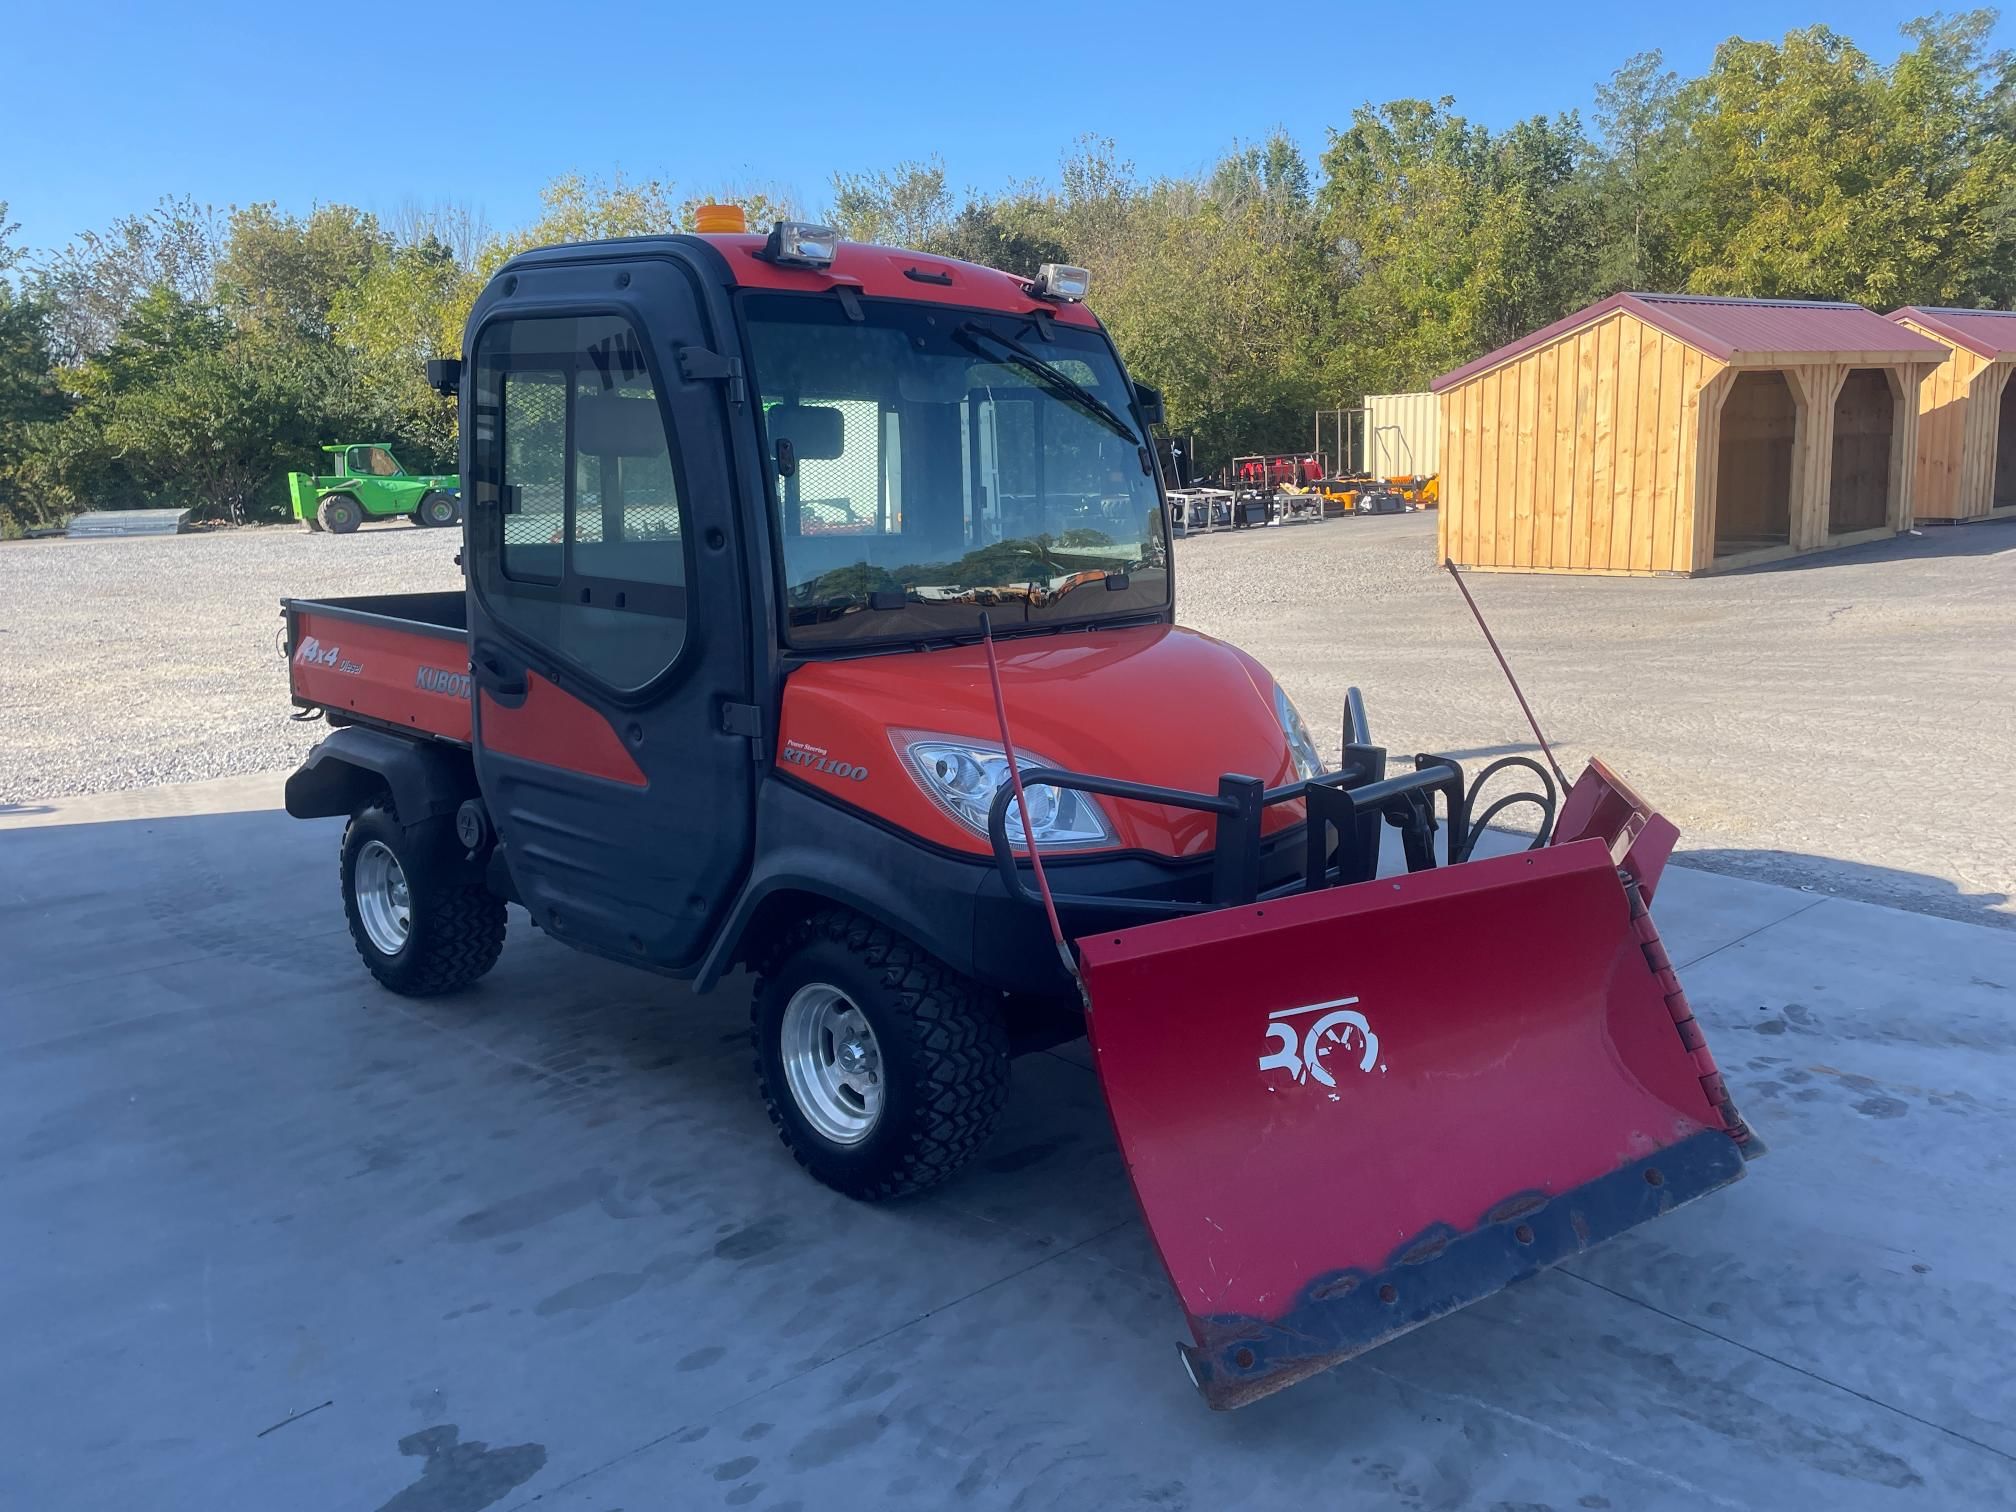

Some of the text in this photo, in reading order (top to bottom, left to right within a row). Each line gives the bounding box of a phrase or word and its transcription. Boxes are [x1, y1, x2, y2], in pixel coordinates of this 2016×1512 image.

[302, 637, 339, 666] 4x4
[788, 740, 827, 755] Power Steering
[784, 748, 867, 780] RTV1100
